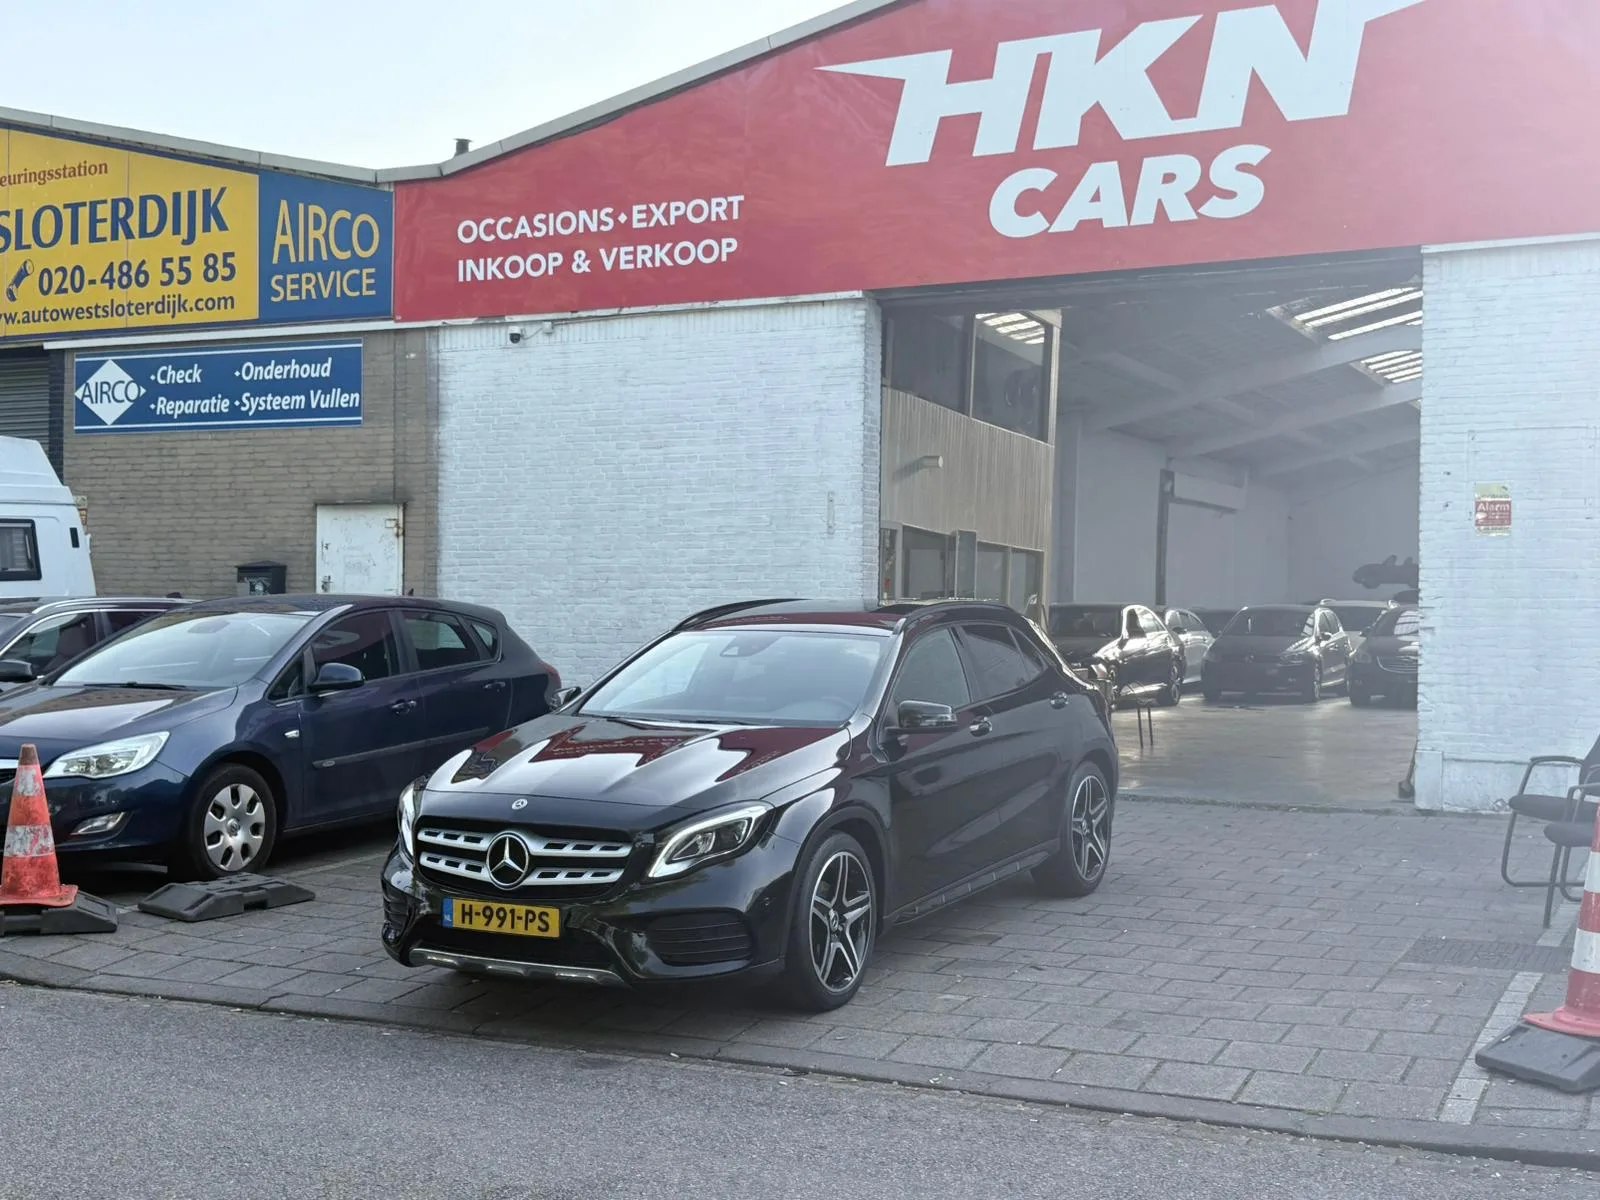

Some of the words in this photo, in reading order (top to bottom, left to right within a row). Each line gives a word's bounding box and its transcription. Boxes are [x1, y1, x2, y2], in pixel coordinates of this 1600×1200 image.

[812, 0, 1426, 167] HKN
[989, 143, 1272, 238] CARS
[272, 199, 380, 265] AIRCO
[457, 207, 615, 244] OCCASIONS
[632, 195, 745, 229] EXPORT
[39, 259, 150, 296] 020-486
[160, 256, 192, 287] 55
[203, 252, 236, 283] 85
[458, 252, 564, 282] INKOOP
[571, 250, 592, 274] &
[599, 237, 738, 271] VERKOOP
[270, 268, 377, 302] SERVICE
[0, 293, 236, 325] w.autowestsloterdijk.com
[156, 363, 203, 385] Check
[241, 357, 333, 381] Onderhoud
[80, 380, 141, 405] AIRCO
[156, 393, 230, 419] Reparatie
[241, 392, 306, 417] Systeem
[310, 387, 361, 409] Vullen
[1477, 502, 1510, 512] Alarm
[461, 903, 550, 932] H-991-PS
